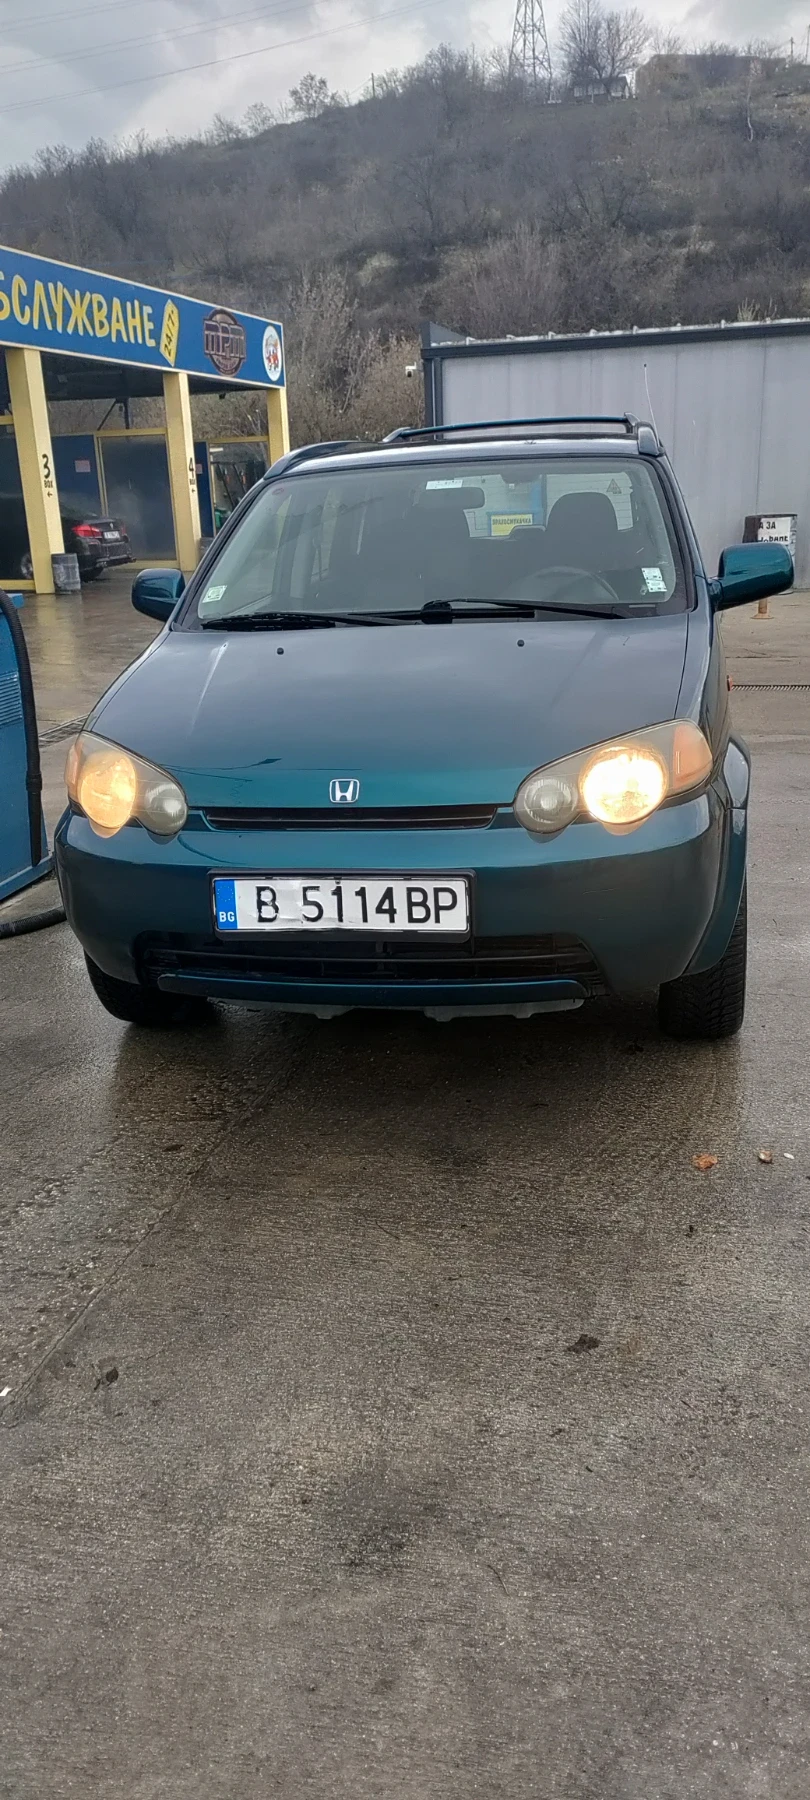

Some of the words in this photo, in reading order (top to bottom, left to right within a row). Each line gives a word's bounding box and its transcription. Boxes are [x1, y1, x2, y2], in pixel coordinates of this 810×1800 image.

[42, 453, 51, 479] 3
[188, 457, 195, 478] 4
[255, 885, 279, 923] B
[219, 911, 235, 922] BG
